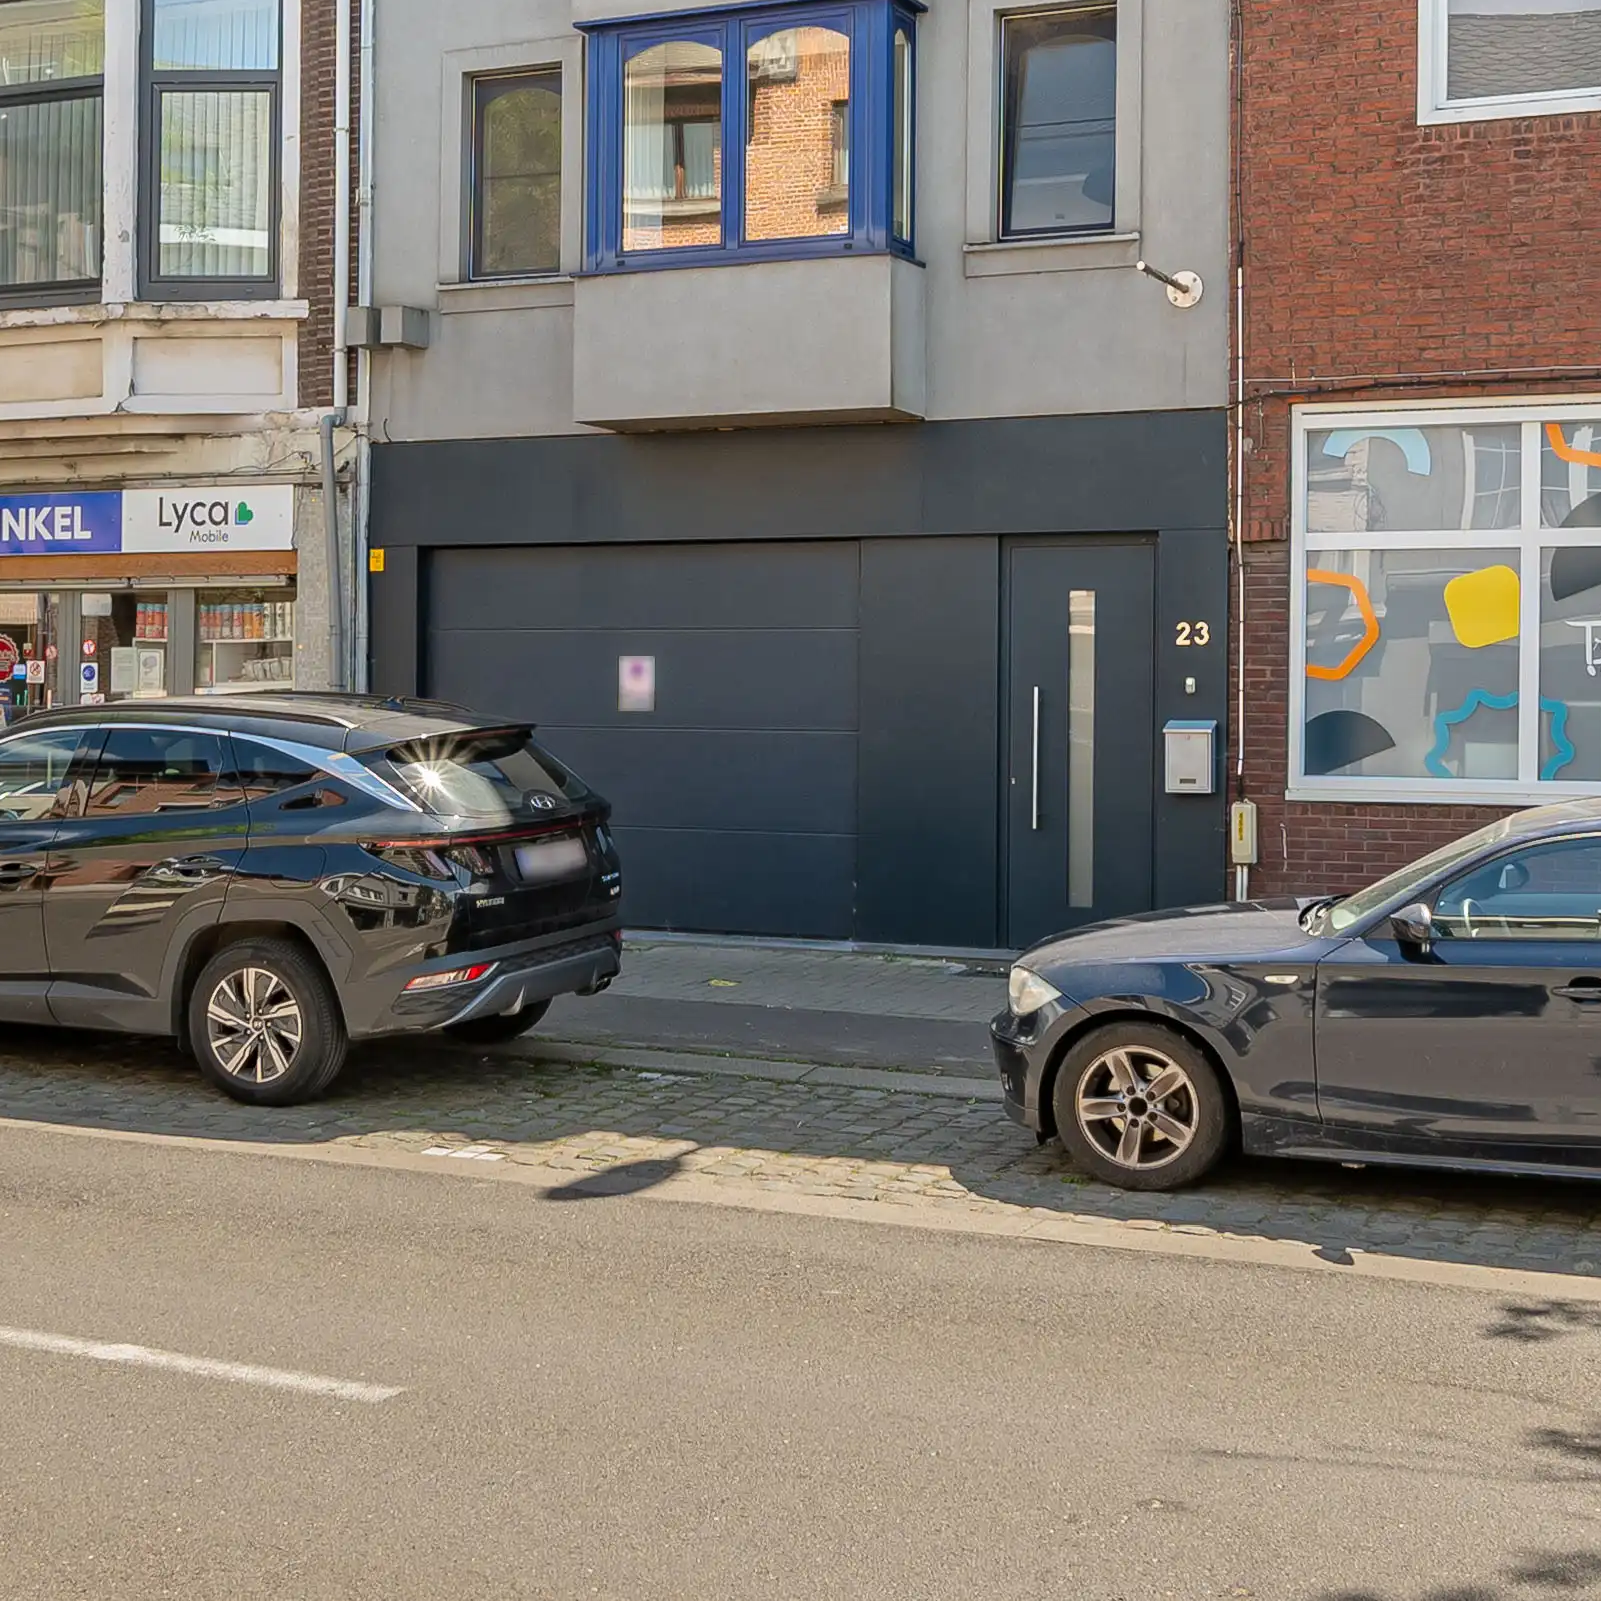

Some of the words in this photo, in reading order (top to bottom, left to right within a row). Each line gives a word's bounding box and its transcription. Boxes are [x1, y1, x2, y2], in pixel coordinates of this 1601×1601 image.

[158, 496, 229, 533] Lyca
[189, 530, 229, 543] Mobile
[1175, 621, 1210, 646] 23
